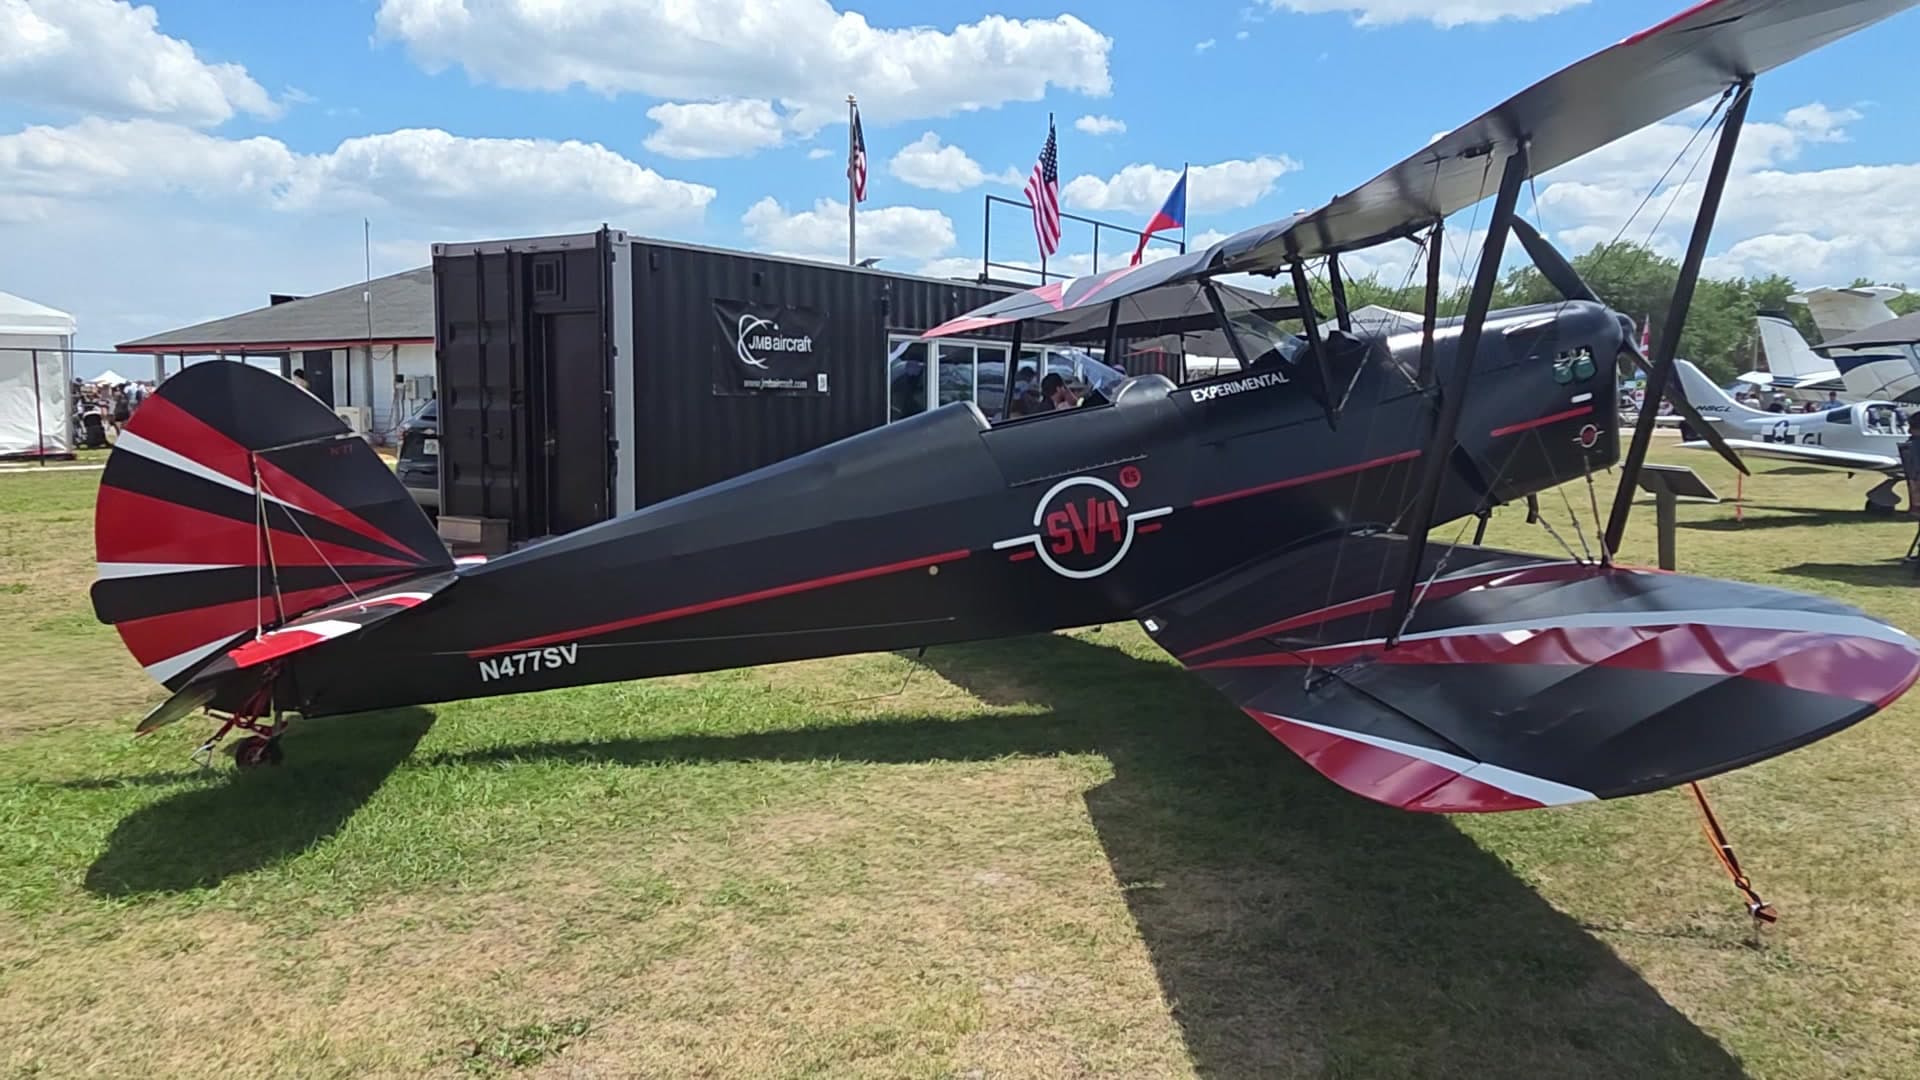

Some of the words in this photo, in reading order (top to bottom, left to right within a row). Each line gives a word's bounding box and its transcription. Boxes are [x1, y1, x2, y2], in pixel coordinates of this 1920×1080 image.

[772, 334, 812, 352] aircraft
[1190, 371, 1290, 403] EXPERIMENTAL
[1047, 497, 1121, 555] SV4
[479, 642, 578, 682] N477SV
